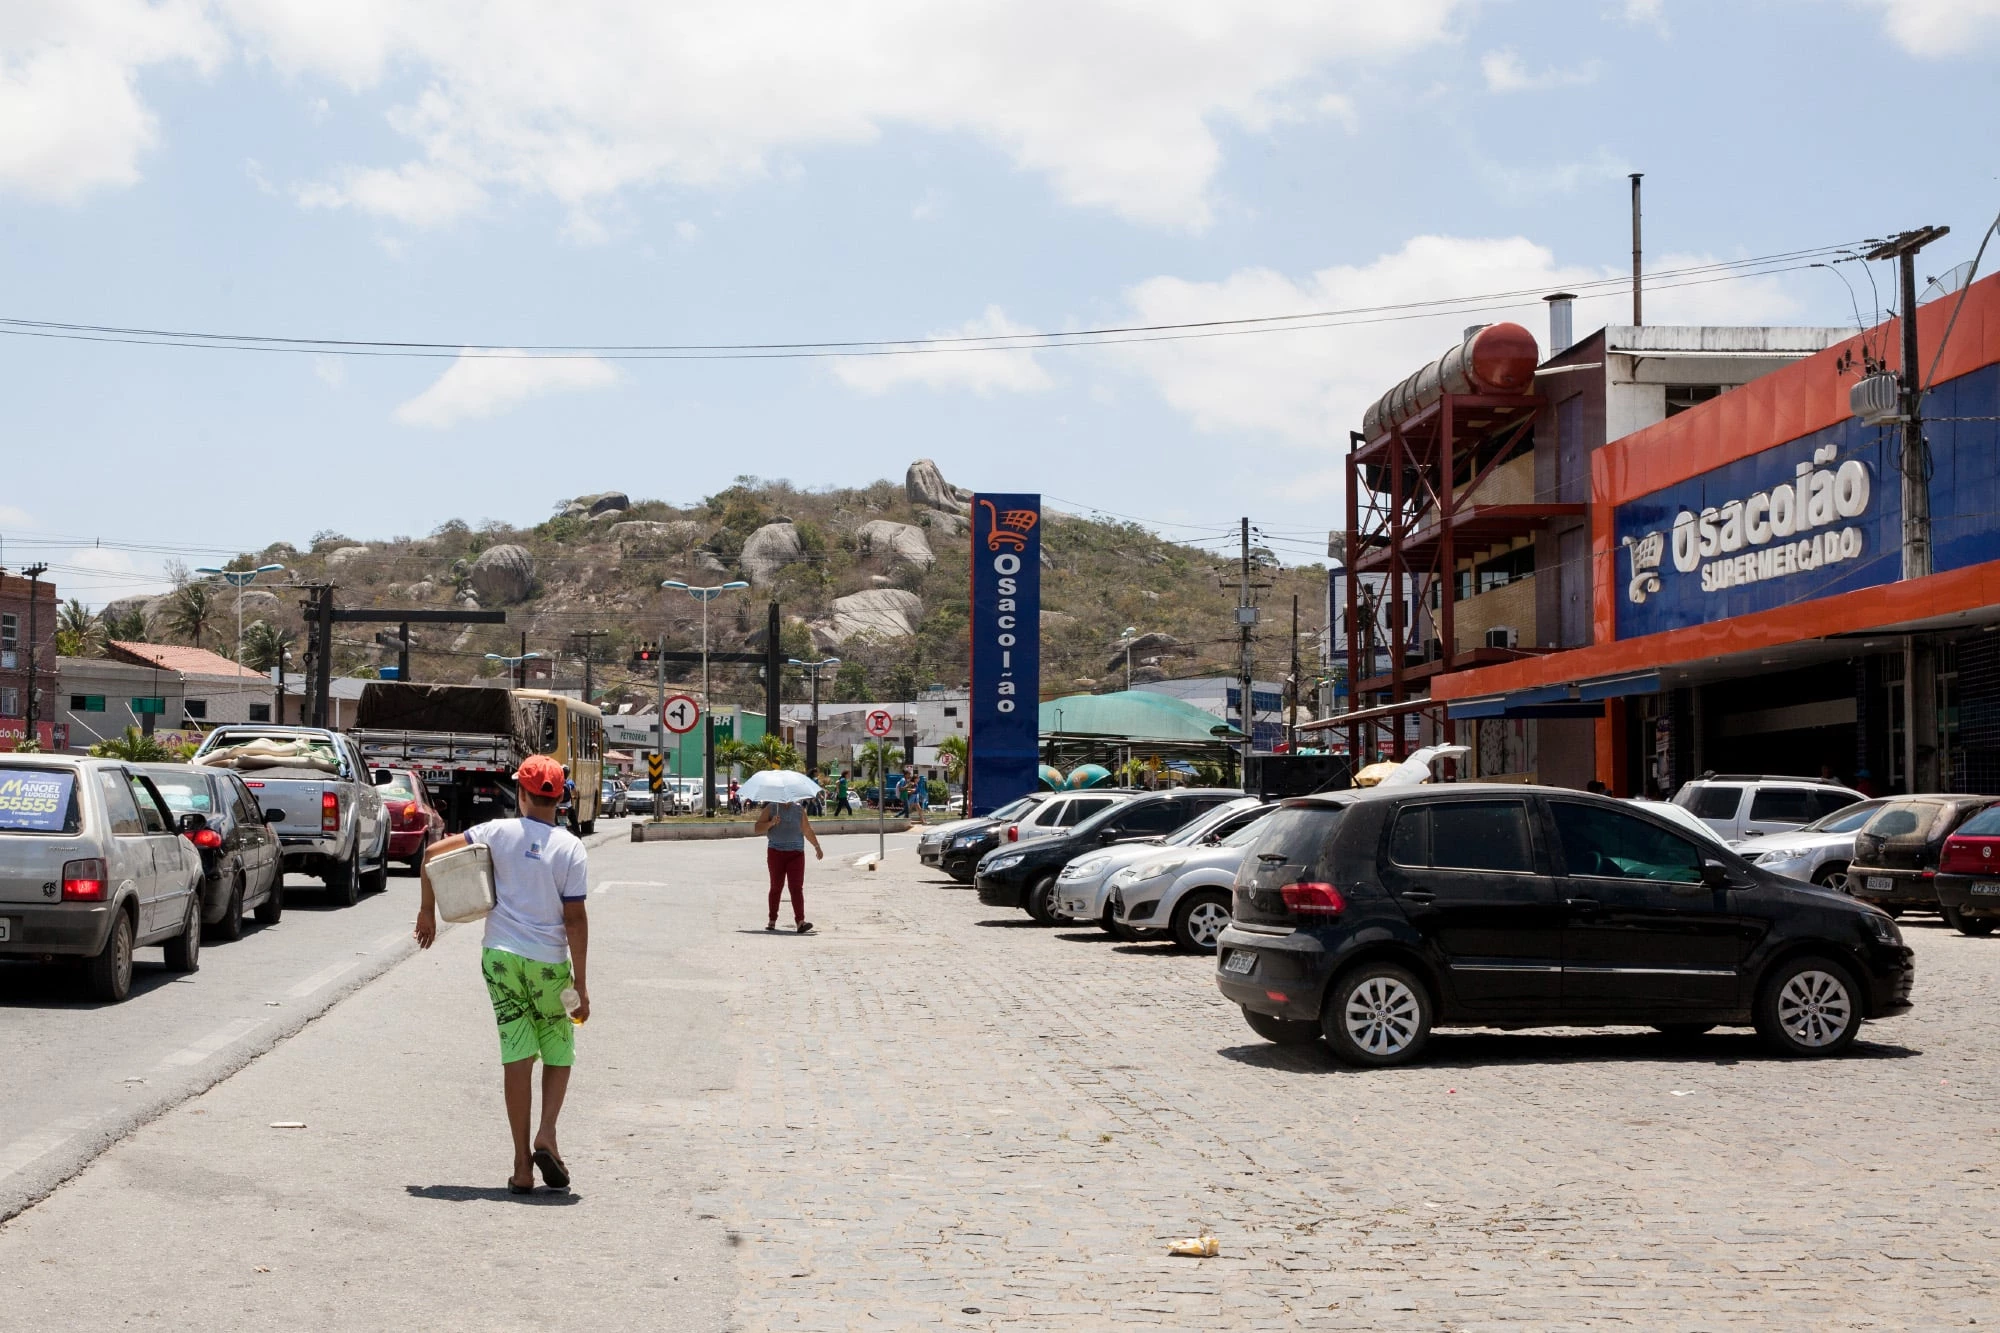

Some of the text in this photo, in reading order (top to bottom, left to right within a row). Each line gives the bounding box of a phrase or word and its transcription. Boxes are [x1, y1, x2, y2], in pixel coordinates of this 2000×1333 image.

[1672, 444, 1870, 573] Osacolão
[1701, 527, 1863, 592] SUPERMERCADO
[713, 715, 731, 726] BR
[0, 778, 61, 796] MANOEL
